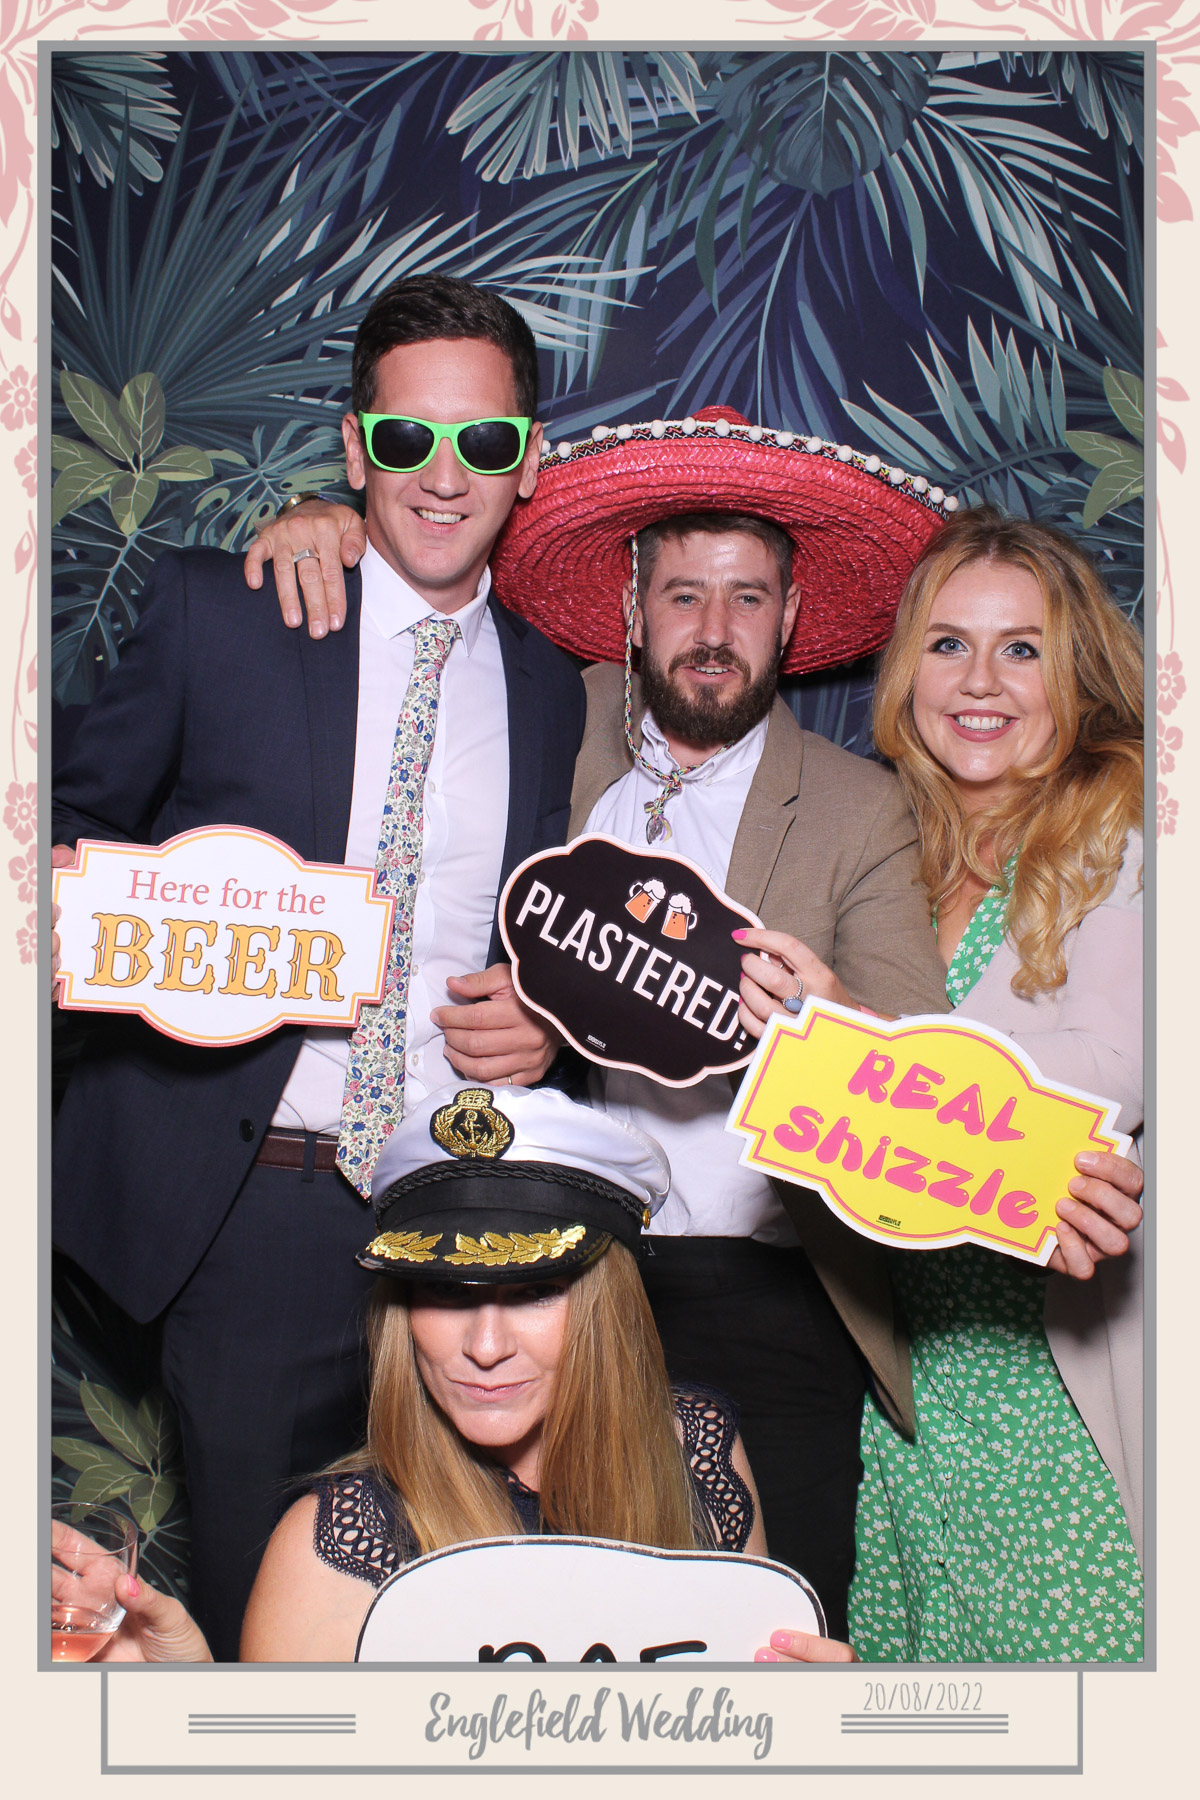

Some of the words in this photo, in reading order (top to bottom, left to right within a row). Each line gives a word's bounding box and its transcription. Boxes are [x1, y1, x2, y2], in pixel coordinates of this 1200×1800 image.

[126, 869, 210, 905] Here
[219, 877, 268, 910] for
[277, 883, 326, 915] the
[84, 912, 346, 1002] BEER
[847, 1049, 1025, 1143] REAL
[773, 1105, 1039, 1229] Shizzle
